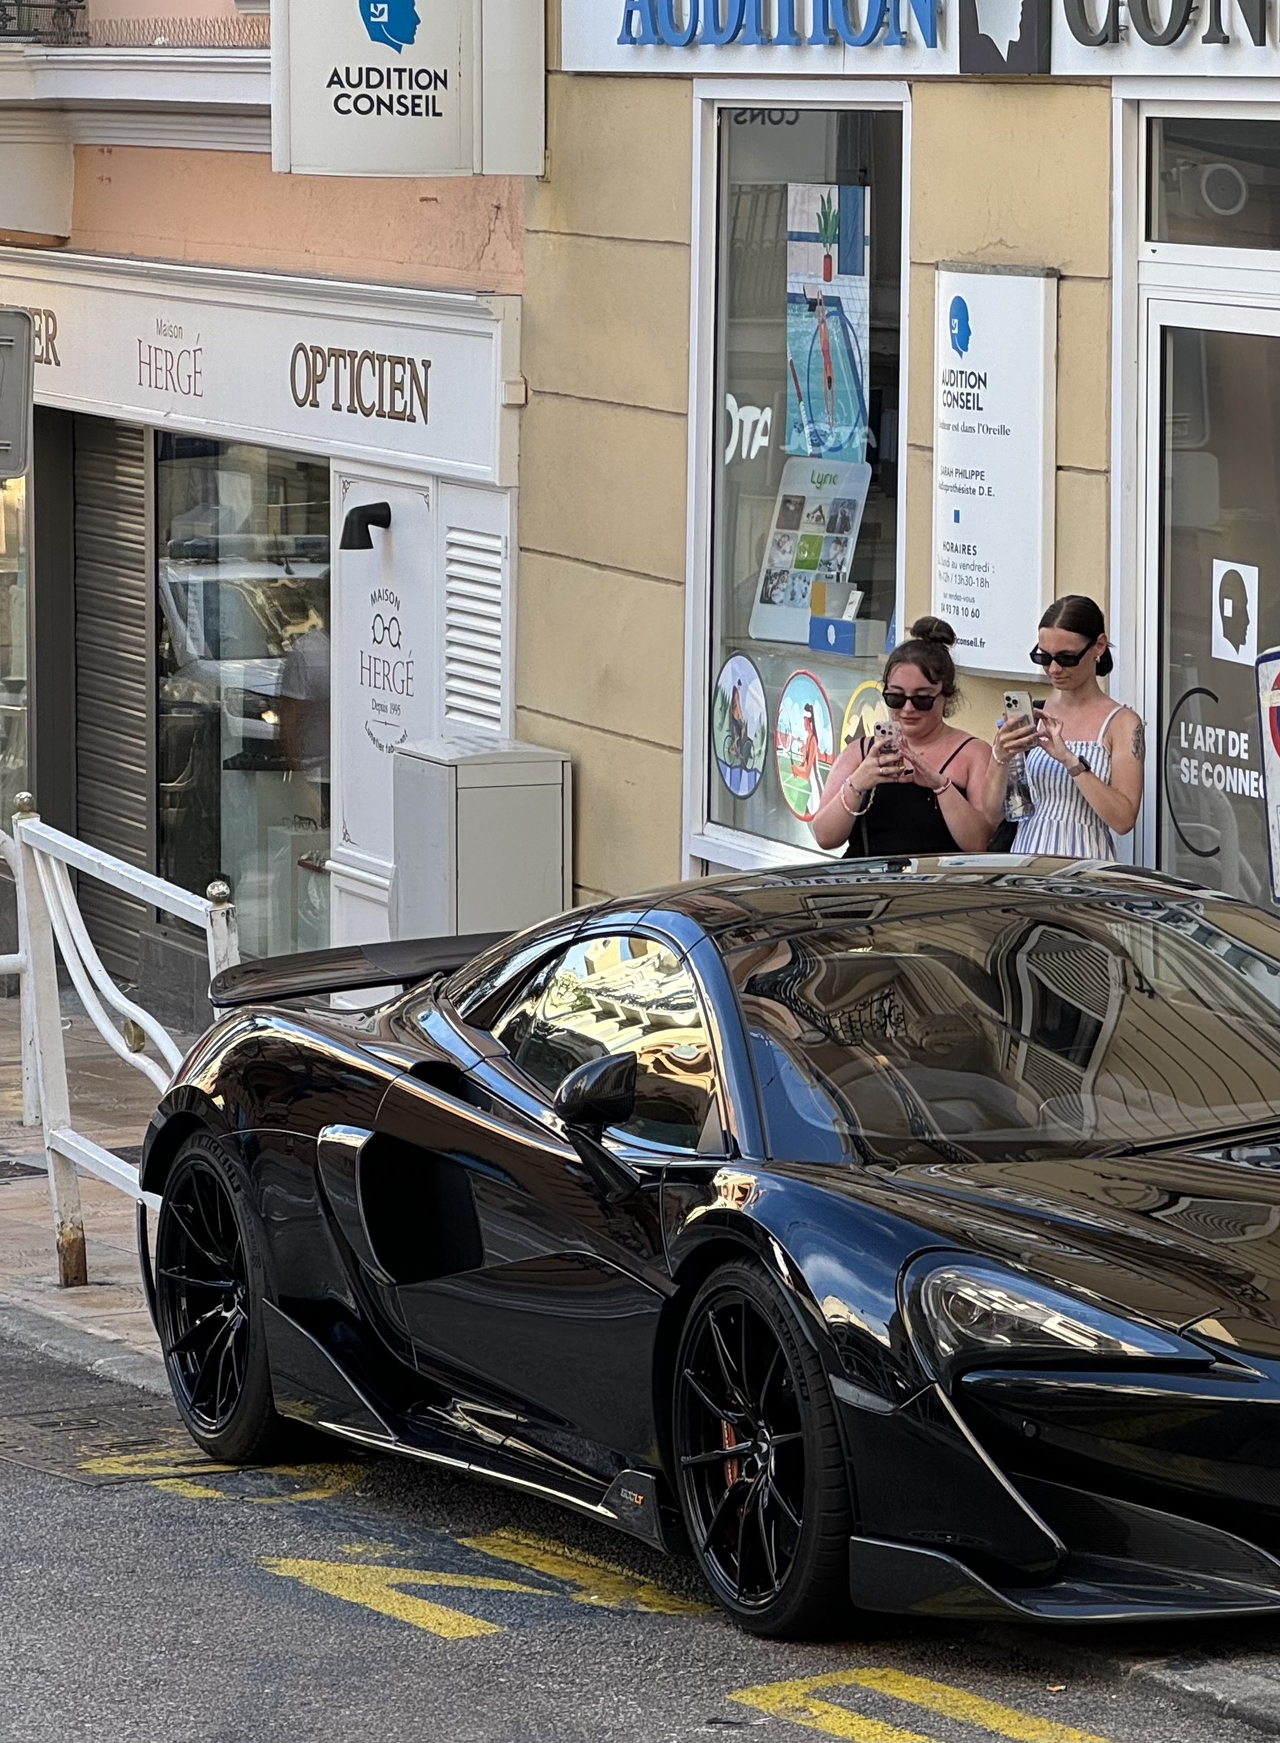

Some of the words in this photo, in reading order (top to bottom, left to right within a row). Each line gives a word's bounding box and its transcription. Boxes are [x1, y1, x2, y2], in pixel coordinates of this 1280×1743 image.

[326, 66, 449, 92] AUDITION
[333, 93, 443, 118] CONSEIL
[156, 318, 183, 339] Maison
[137, 333, 204, 398] HERGÉ
[290, 342, 431, 425] OPTICIEN
[942, 368, 987, 390] AUDITION
[942, 390, 984, 412] CONSEIL
[960, 421, 976, 433] dans
[977, 422, 1011, 436] l'Oreille
[955, 468, 985, 481] PHILIPPE
[978, 486, 995, 497] D.E.
[943, 541, 977, 556] HORAIRES
[960, 560, 989, 572] vendredi
[370, 588, 400, 611] MAISON
[953, 605, 959, 616] 78
[961, 607, 969, 617] 10
[971, 608, 980, 619] 60
[360, 650, 414, 697] HERGÉ
[372, 699, 388, 715] Depuis
[1181, 722, 1225, 754] L'ART
[1228, 730, 1249, 760] DE
[1181, 757, 1198, 785] SE
